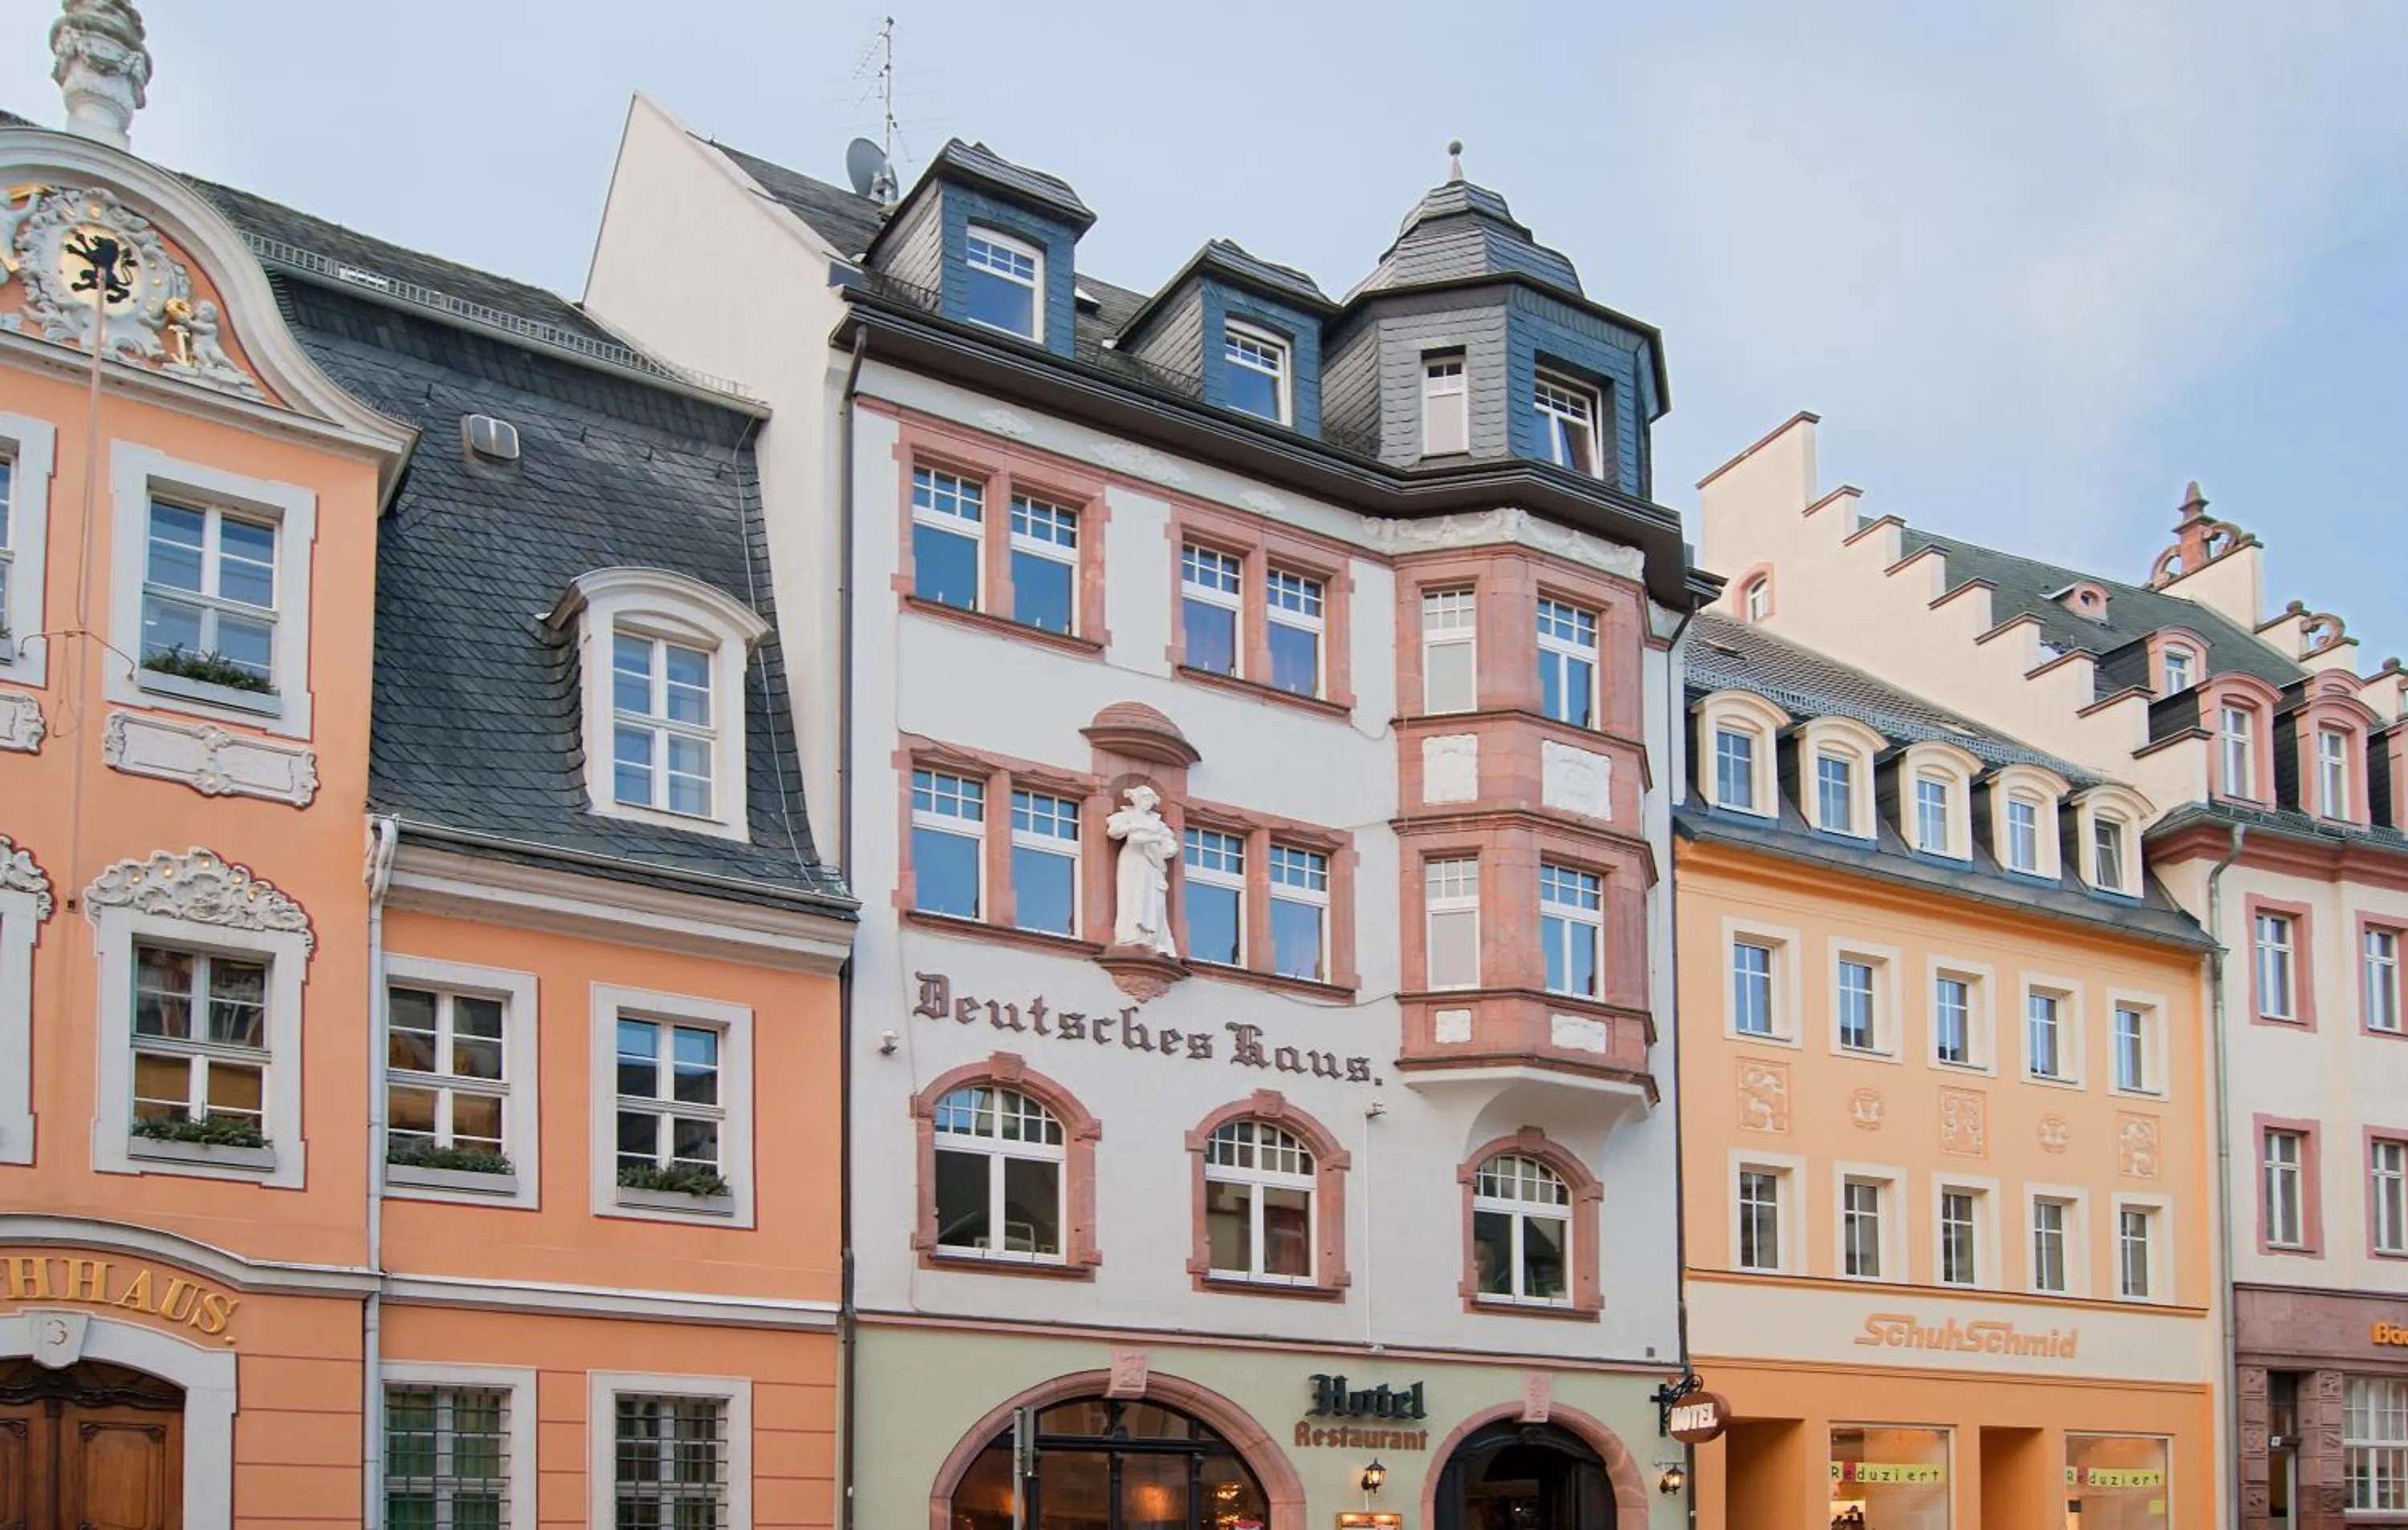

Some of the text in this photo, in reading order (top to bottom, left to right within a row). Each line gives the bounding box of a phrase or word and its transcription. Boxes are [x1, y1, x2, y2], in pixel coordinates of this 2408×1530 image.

[913, 970, 1214, 1060] Deutsches
[0, 1256, 240, 1345] HHAUS.
[47, 1319, 67, 1346] 3
[1853, 1312, 2078, 1358] SchuhSchmid
[1304, 1373, 1428, 1420] Hotel
[1295, 1420, 1429, 1451] Restaurant
[1670, 1402, 1718, 1431] HOTEL
[1831, 1466, 1939, 1481] Reduziert
